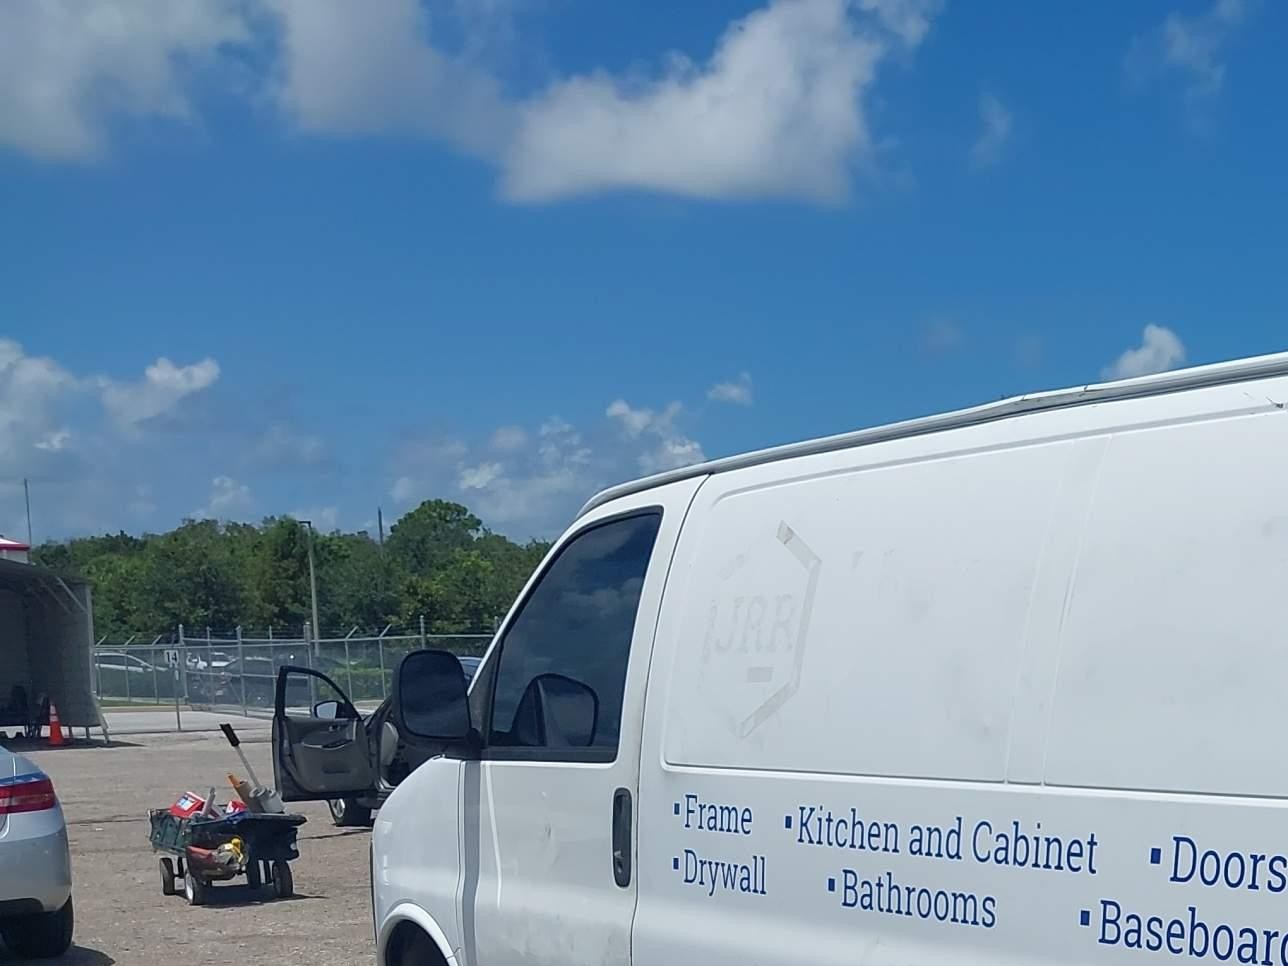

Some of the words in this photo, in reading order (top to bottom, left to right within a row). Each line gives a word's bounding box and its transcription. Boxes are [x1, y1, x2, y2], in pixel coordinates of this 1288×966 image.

[685, 794, 752, 834] Frame
[797, 805, 900, 853] Kitchen
[908, 816, 963, 860] and
[973, 821, 1098, 875] Cabinet
[684, 849, 767, 896] Drywall
[1169, 836, 1288, 892] Doors
[841, 868, 996, 928] Bathrooms
